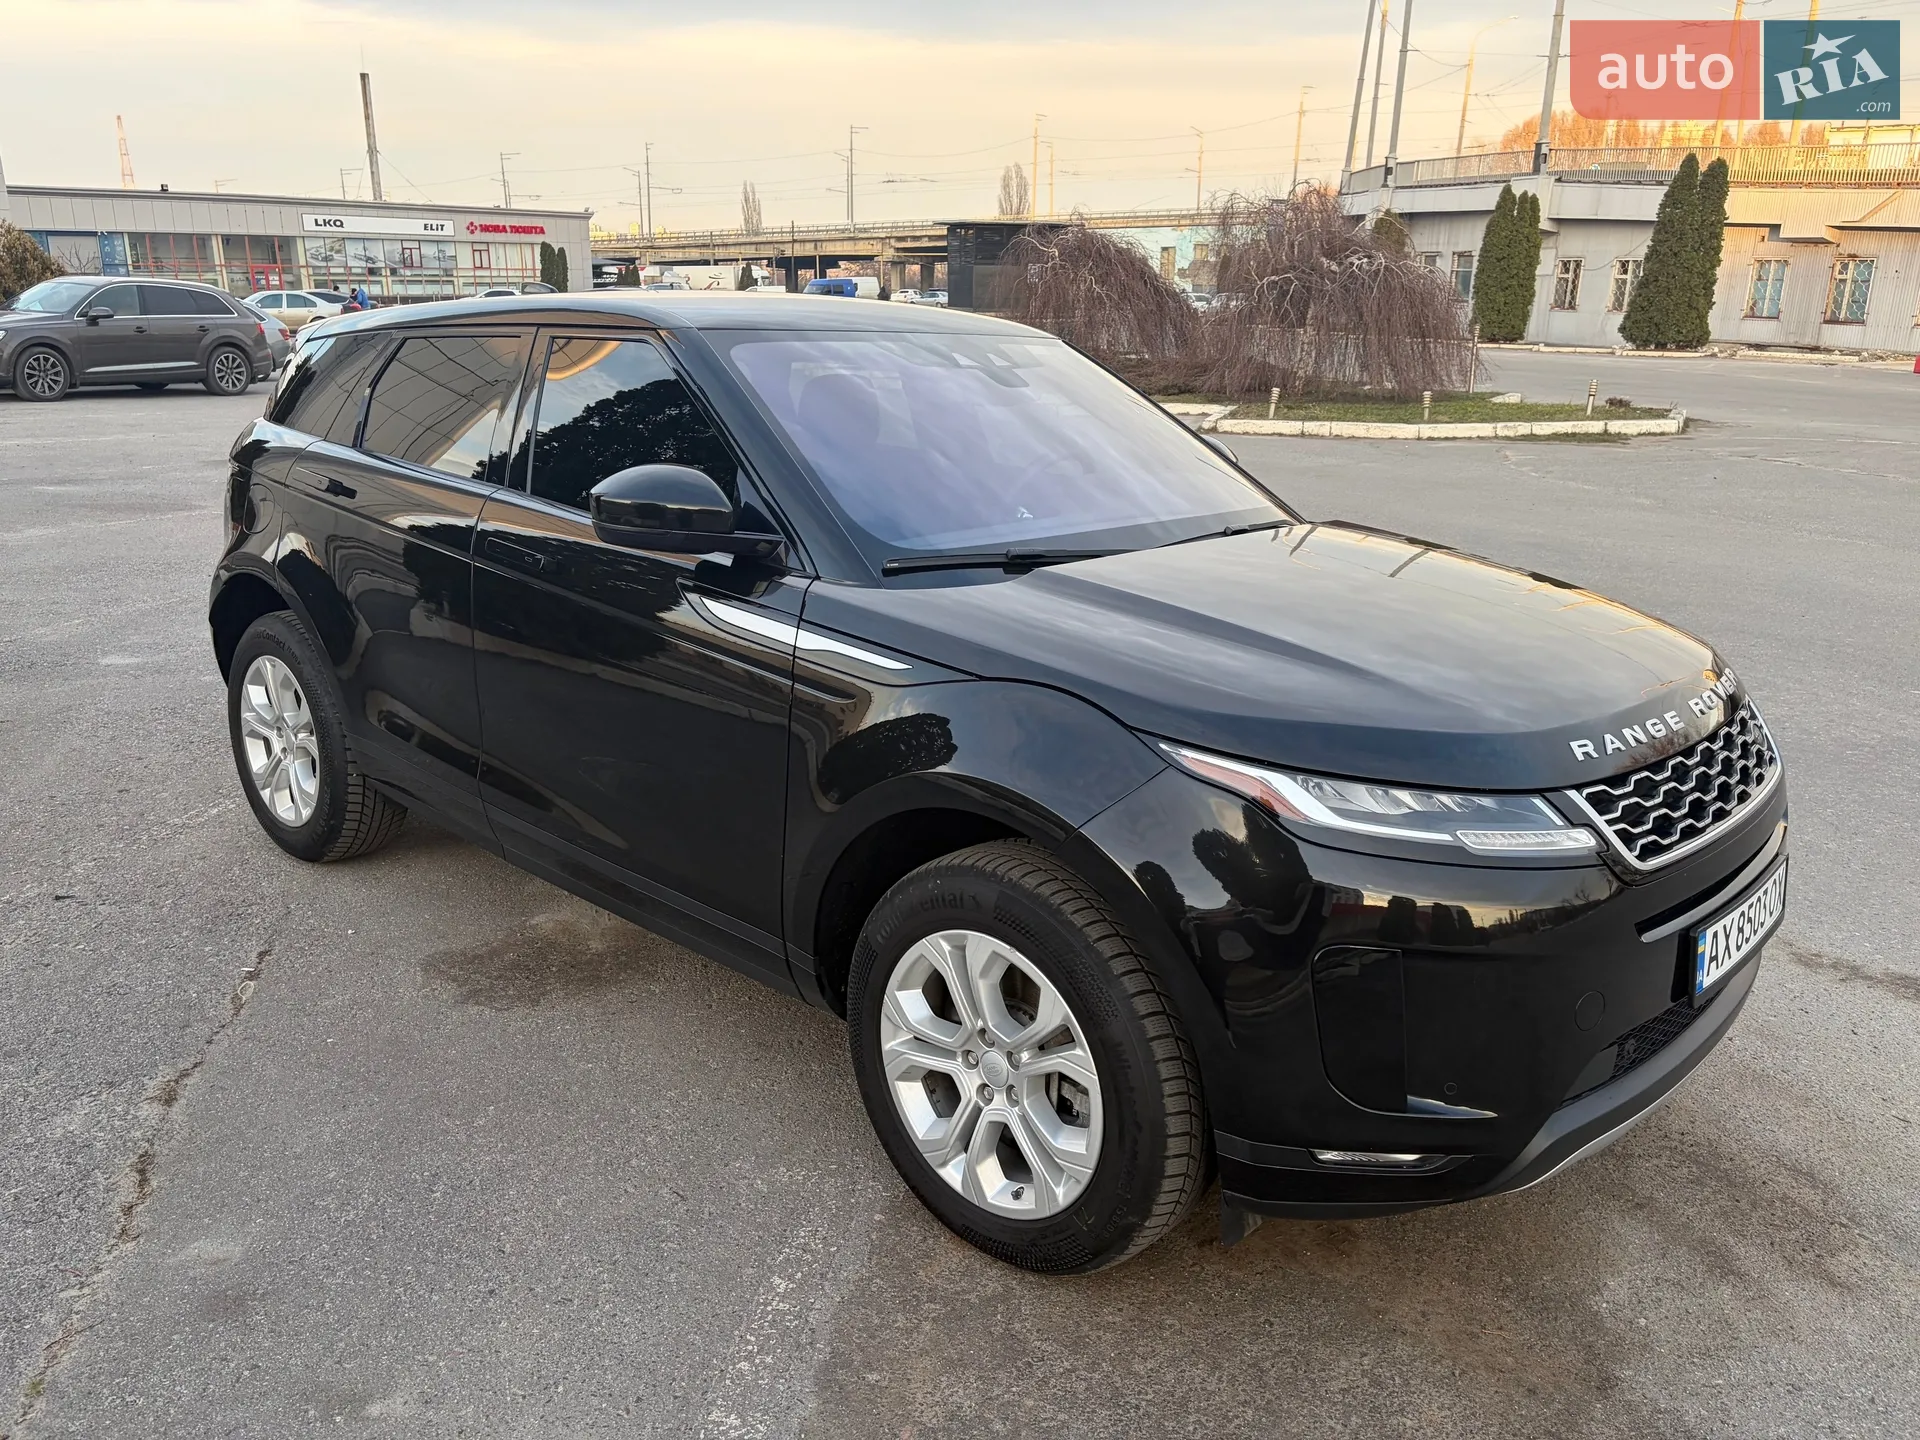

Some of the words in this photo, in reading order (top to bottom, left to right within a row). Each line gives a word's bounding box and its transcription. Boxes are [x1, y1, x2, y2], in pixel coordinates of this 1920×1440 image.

[314, 218, 345, 229] LKQ
[479, 223, 508, 234] НОВА
[509, 224, 546, 235] ПОШТА
[1568, 710, 1685, 762] RANGE
[1688, 667, 1739, 718] ROVER
[1706, 916, 1735, 978] AX
[1735, 886, 1769, 953] 8503
